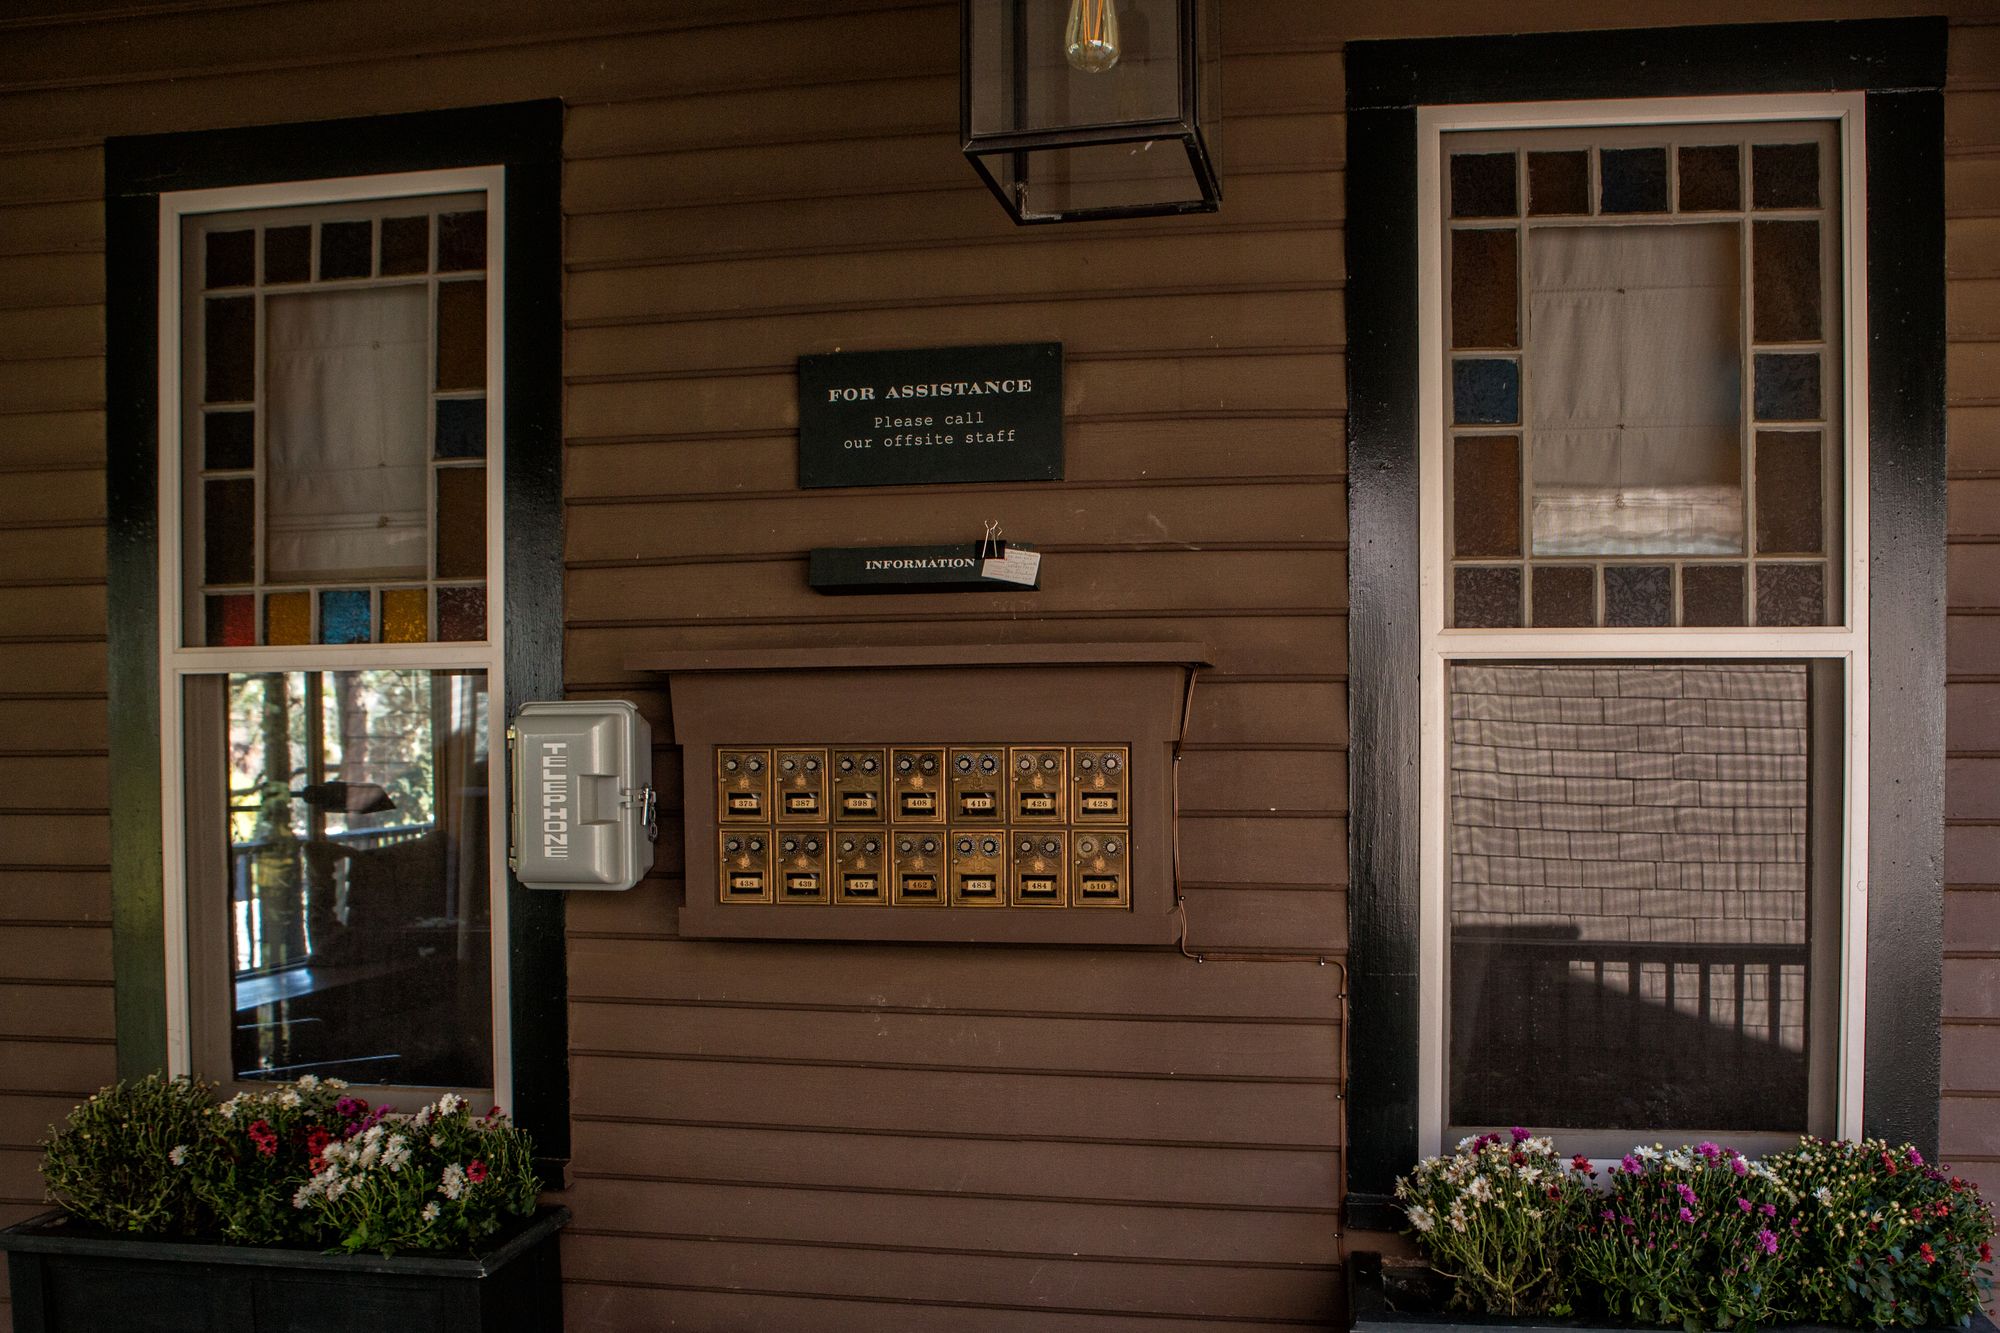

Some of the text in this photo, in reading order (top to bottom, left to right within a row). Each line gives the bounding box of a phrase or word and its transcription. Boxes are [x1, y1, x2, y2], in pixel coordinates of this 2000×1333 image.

[828, 379, 1032, 402] FOR ASSISTANCE
[874, 411, 984, 429] Please call
[844, 430, 1016, 449] our offsite staff
[865, 557, 975, 570] INFORMATION
[543, 743, 568, 858] TELEPHONE
